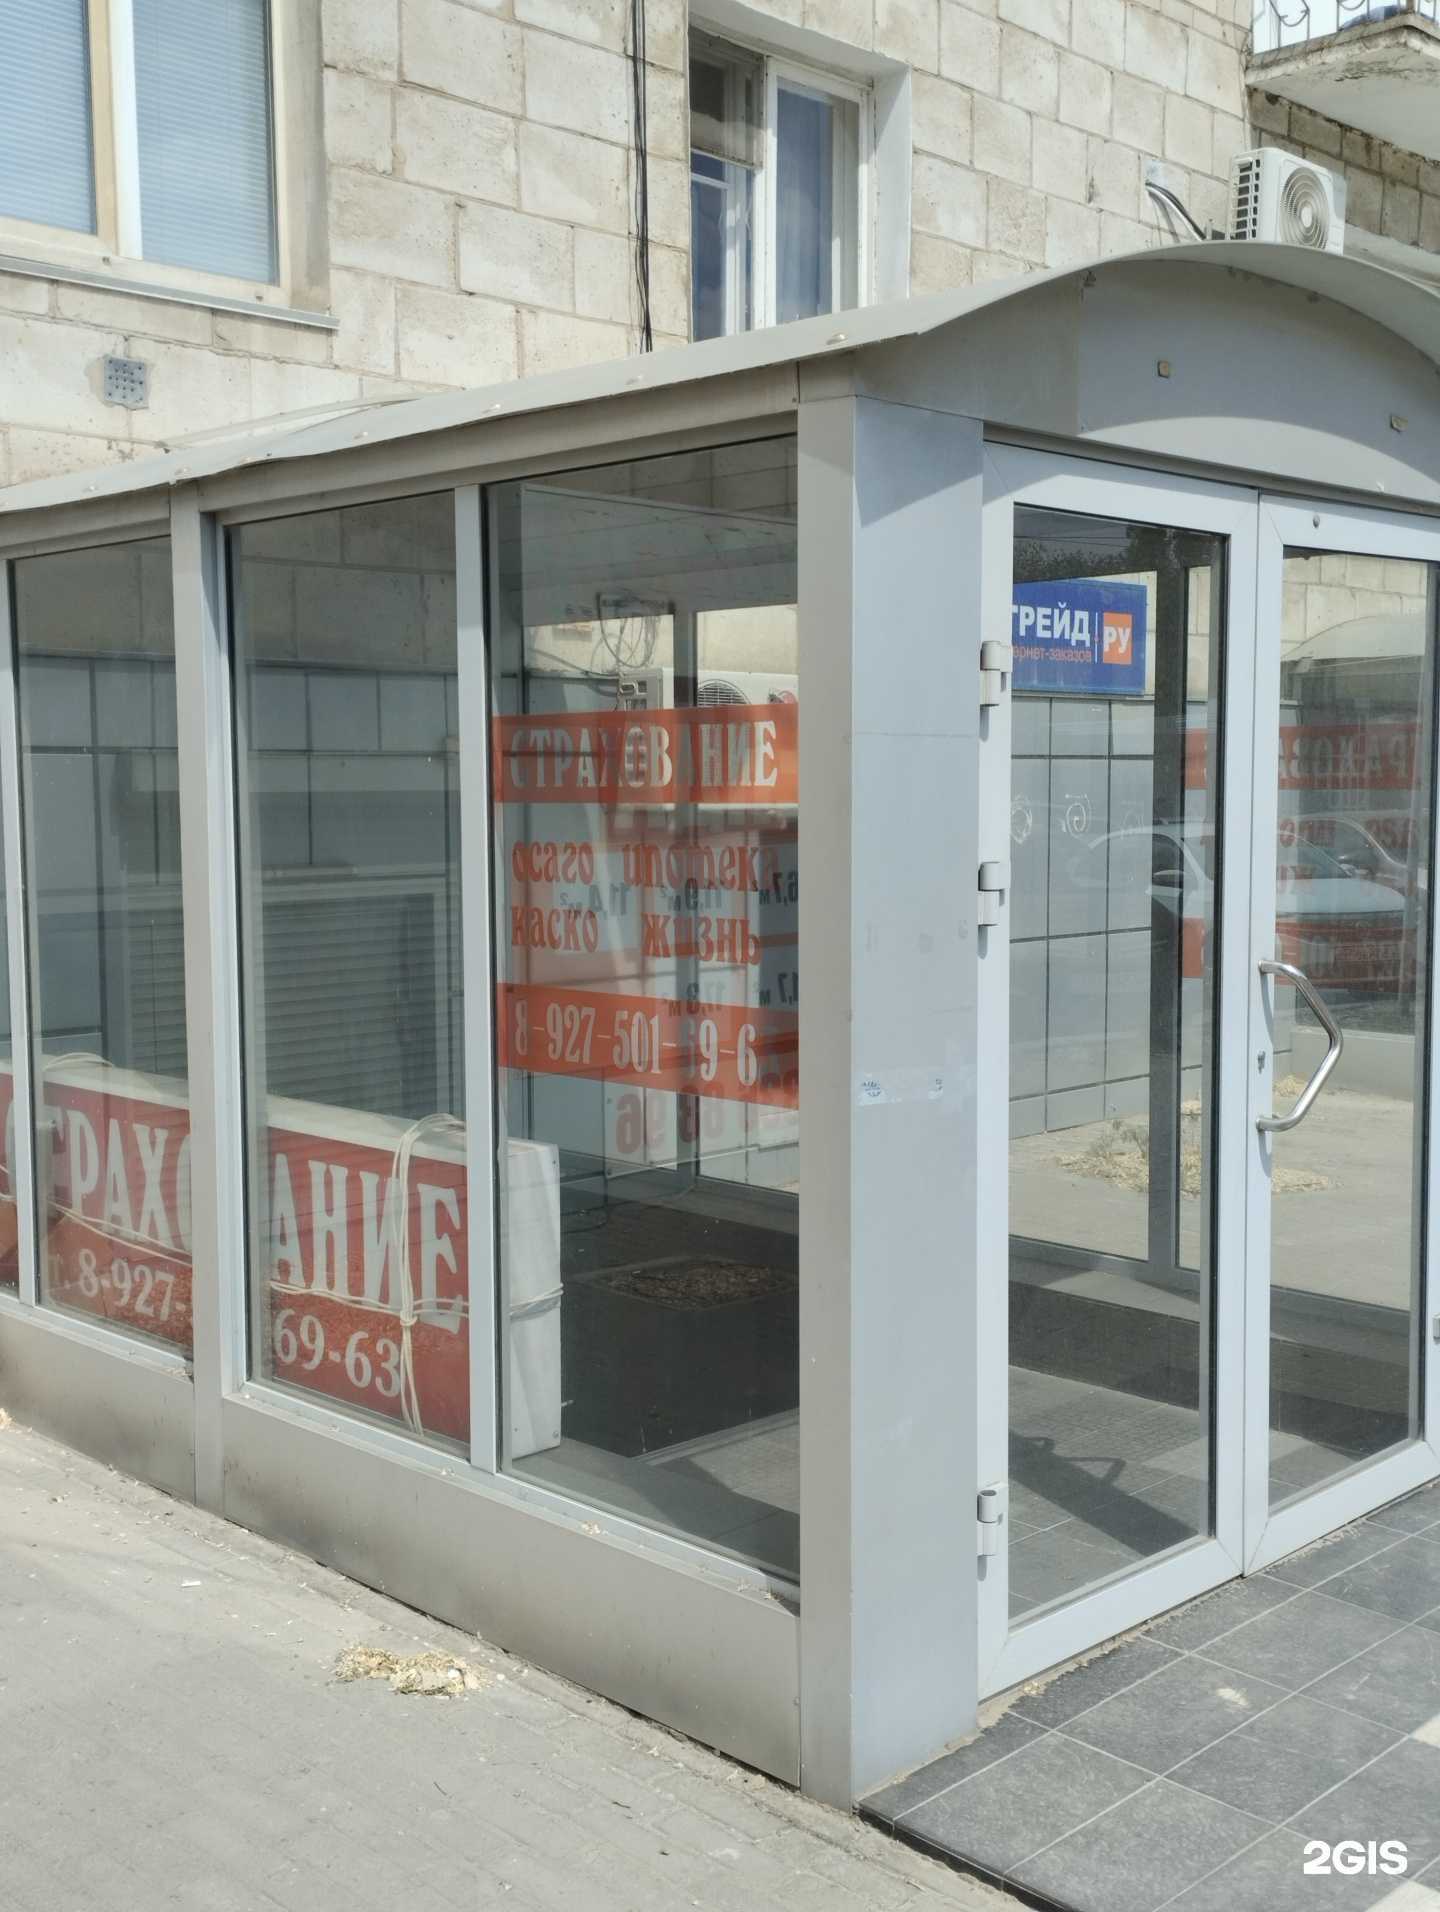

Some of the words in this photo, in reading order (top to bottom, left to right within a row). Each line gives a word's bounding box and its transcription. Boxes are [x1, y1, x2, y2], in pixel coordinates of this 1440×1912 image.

[1103, 626, 1131, 653] РУ
[509, 720, 777, 788] СТРАХОВАНИЕ
[512, 841, 594, 885] осаго
[511, 906, 598, 952] каско
[641, 912, 762, 965] жизнь
